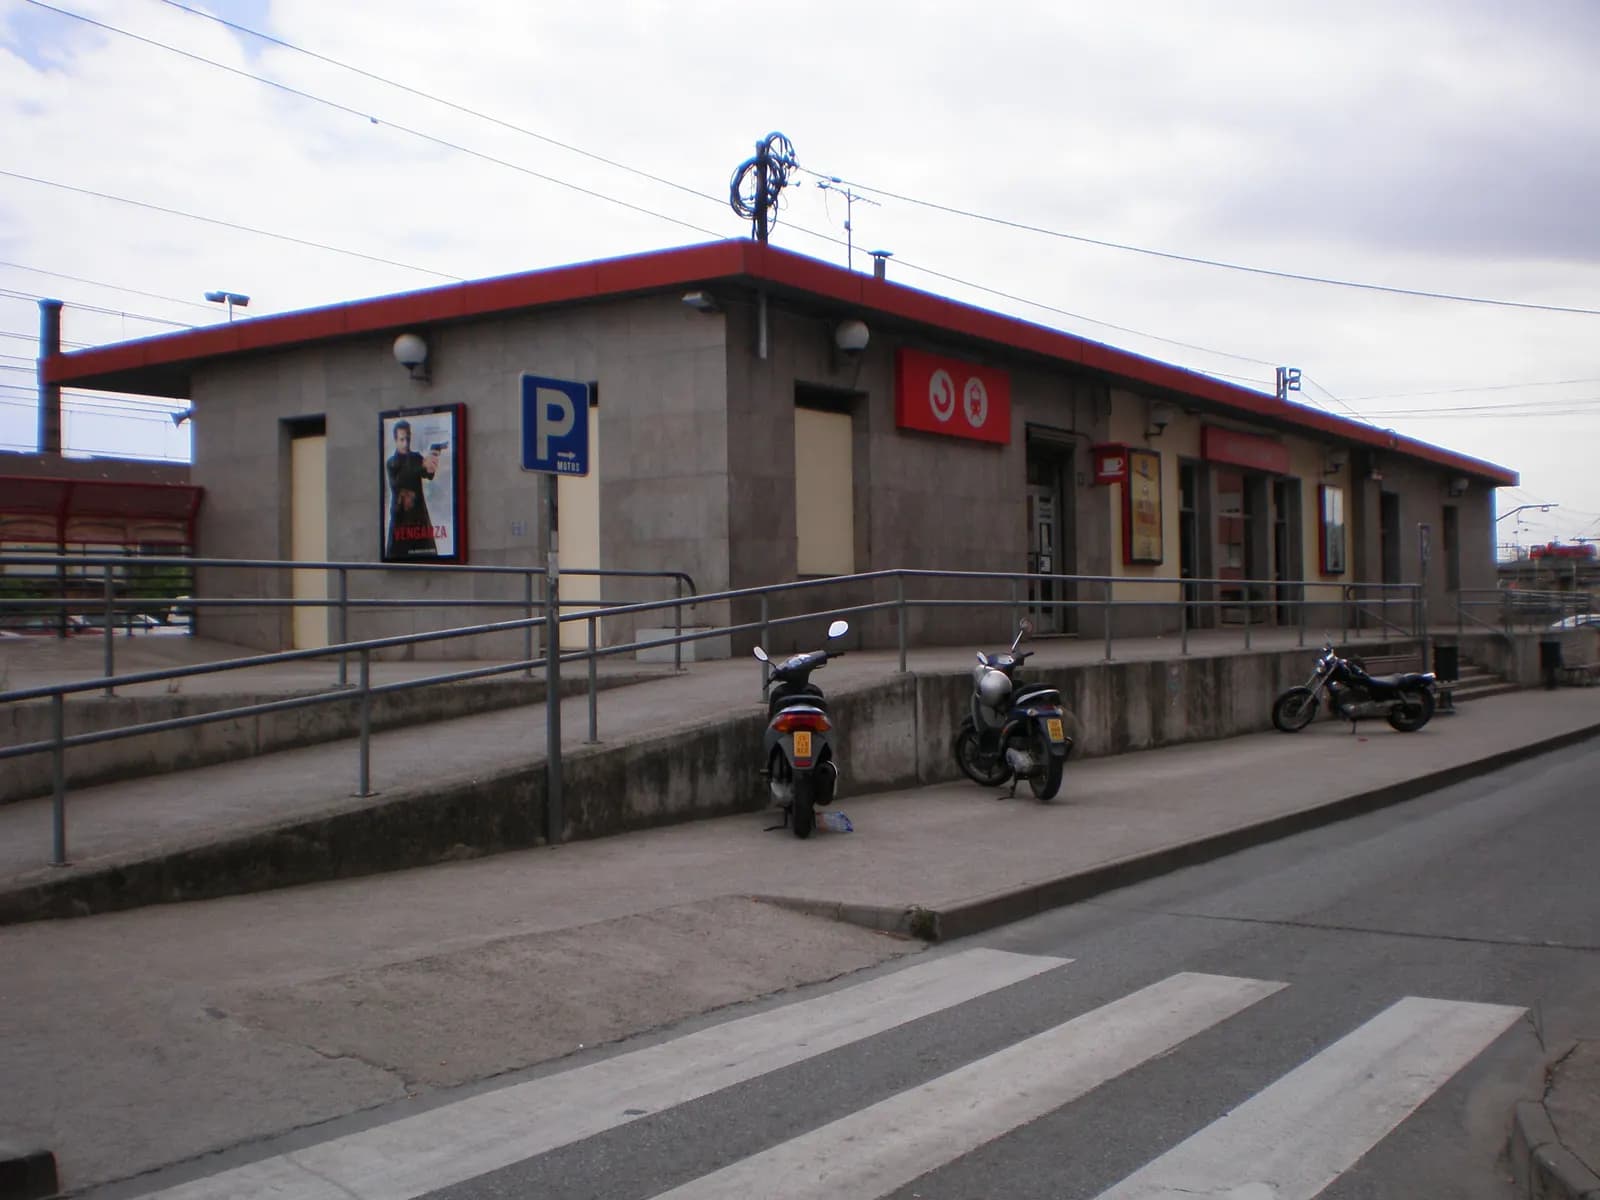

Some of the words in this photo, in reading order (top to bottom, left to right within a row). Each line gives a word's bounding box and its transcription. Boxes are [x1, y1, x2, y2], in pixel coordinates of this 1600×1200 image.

[536, 387, 575, 461] P
[557, 460, 580, 472] MOTOS
[394, 525, 448, 540] VENGANZA
